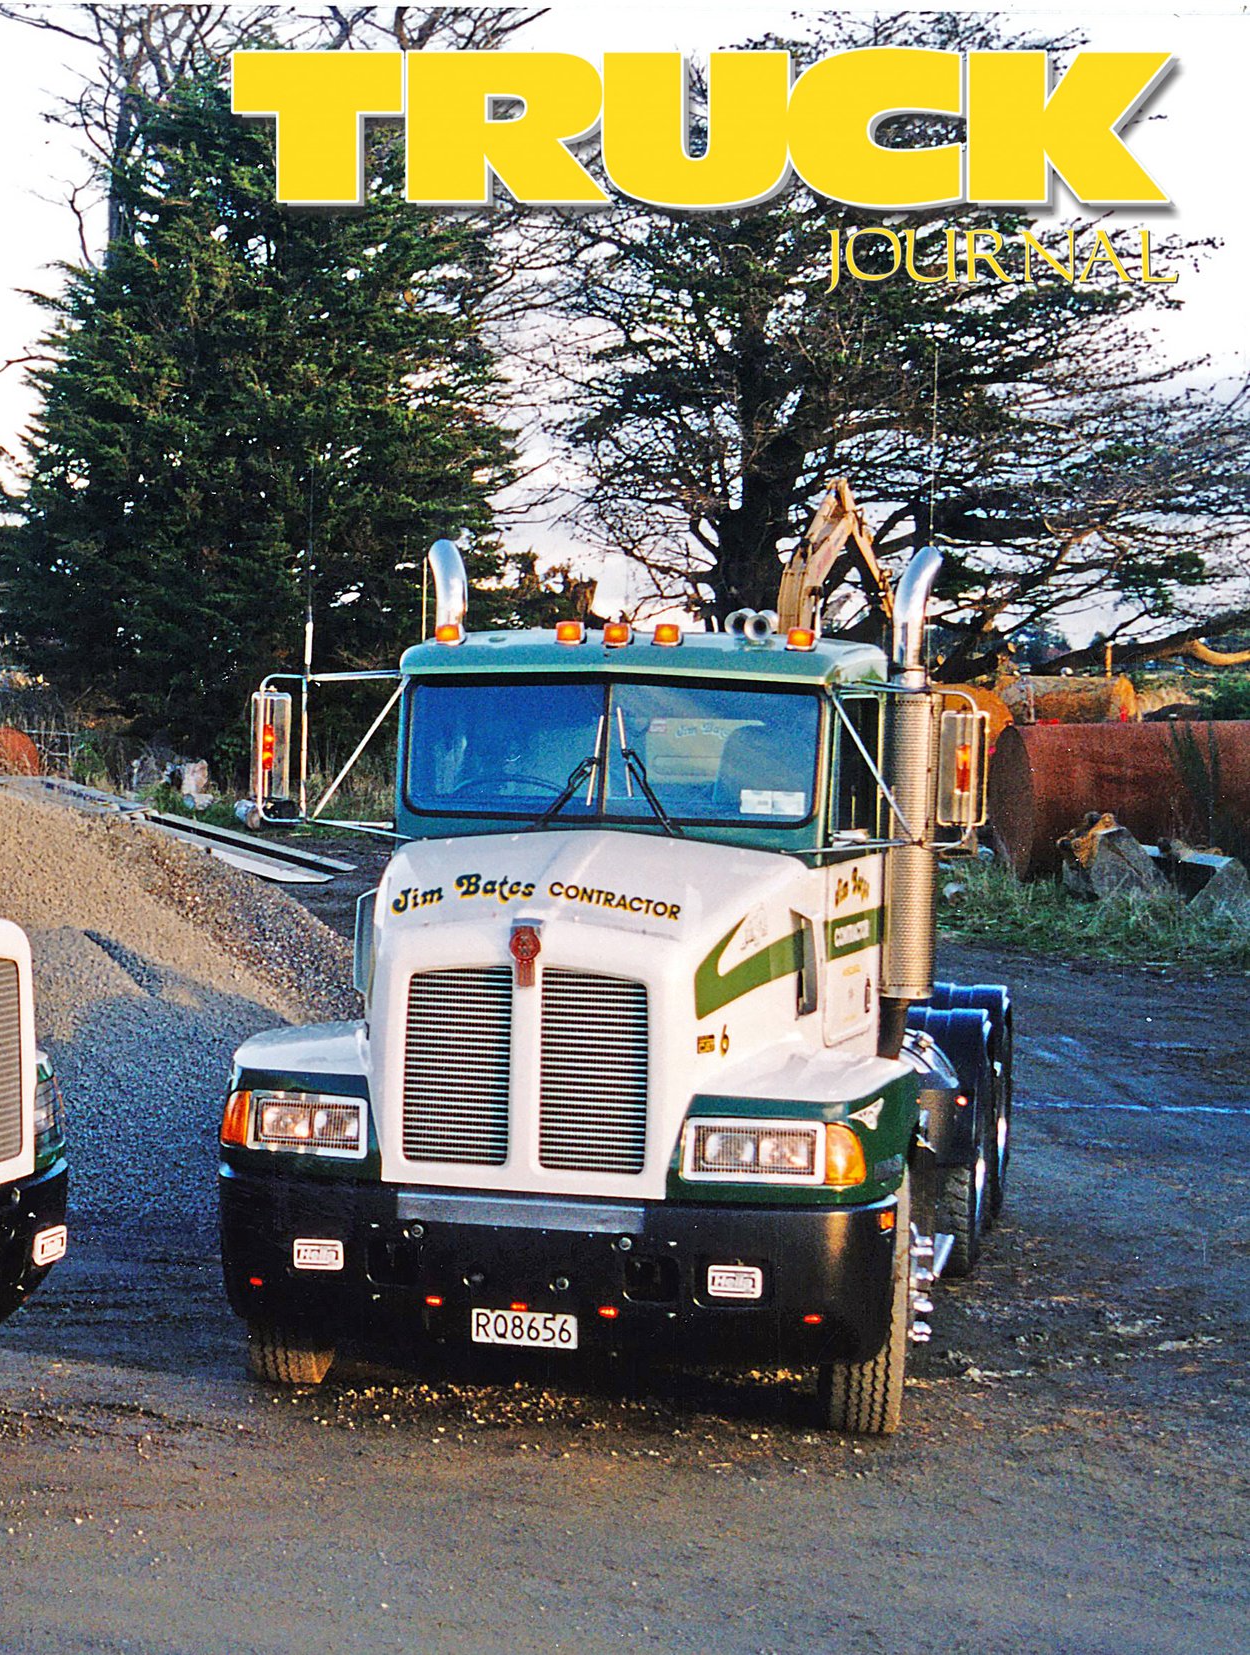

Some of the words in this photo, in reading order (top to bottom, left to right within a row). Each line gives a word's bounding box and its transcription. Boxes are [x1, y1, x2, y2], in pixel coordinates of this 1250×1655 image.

[391, 884, 444, 916] Jim
[453, 873, 536, 904] Bates
[548, 881, 682, 920] CONTRACTOR
[720, 1024, 730, 1057] 6
[475, 1311, 572, 1344] RQ8656
